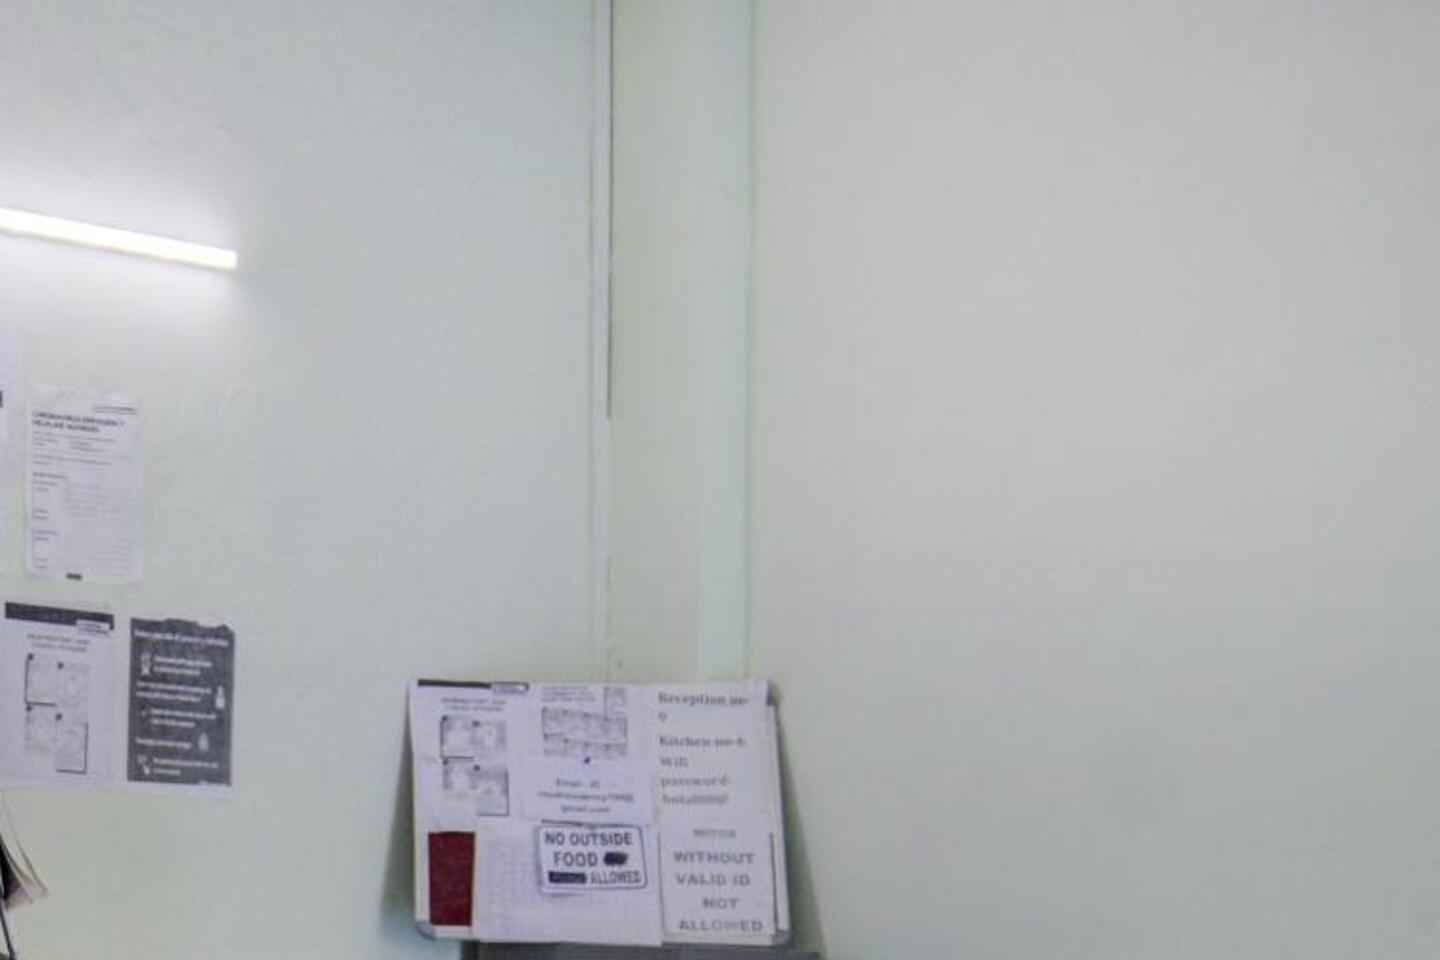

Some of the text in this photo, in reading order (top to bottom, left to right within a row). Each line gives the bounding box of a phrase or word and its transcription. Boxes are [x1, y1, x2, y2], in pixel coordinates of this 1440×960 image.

[544, 831, 633, 847] NO OUTSIDE
[553, 850, 598, 867] FOOD
[673, 850, 756, 864] WITHOUT
[590, 870, 642, 884] ALLOWED
[674, 873, 751, 886] VALID ID
[701, 897, 739, 909] NOT
[678, 919, 764, 932] ALLOWED
